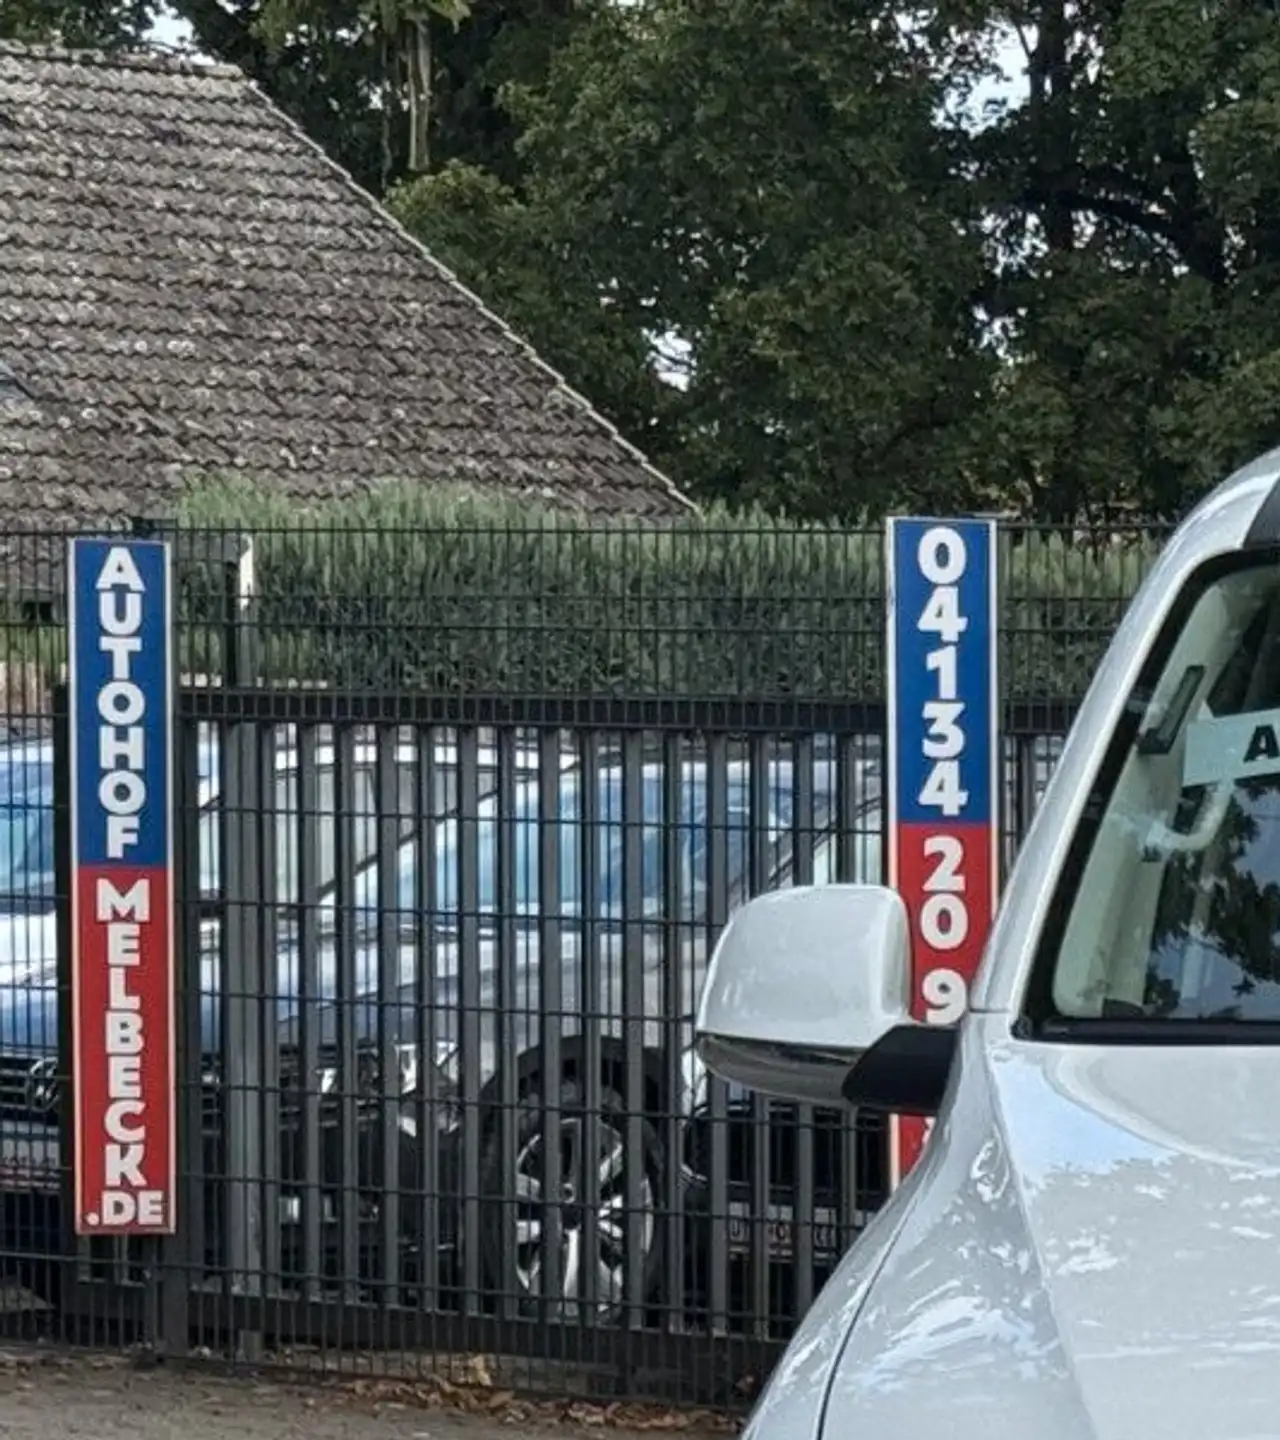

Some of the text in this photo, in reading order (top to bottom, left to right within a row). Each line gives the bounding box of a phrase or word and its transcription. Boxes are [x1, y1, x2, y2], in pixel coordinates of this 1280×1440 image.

[916, 527, 969, 817] 04134
[95, 547, 150, 1187] AUTOHOF MELBECK
[921, 835, 969, 950] 20
